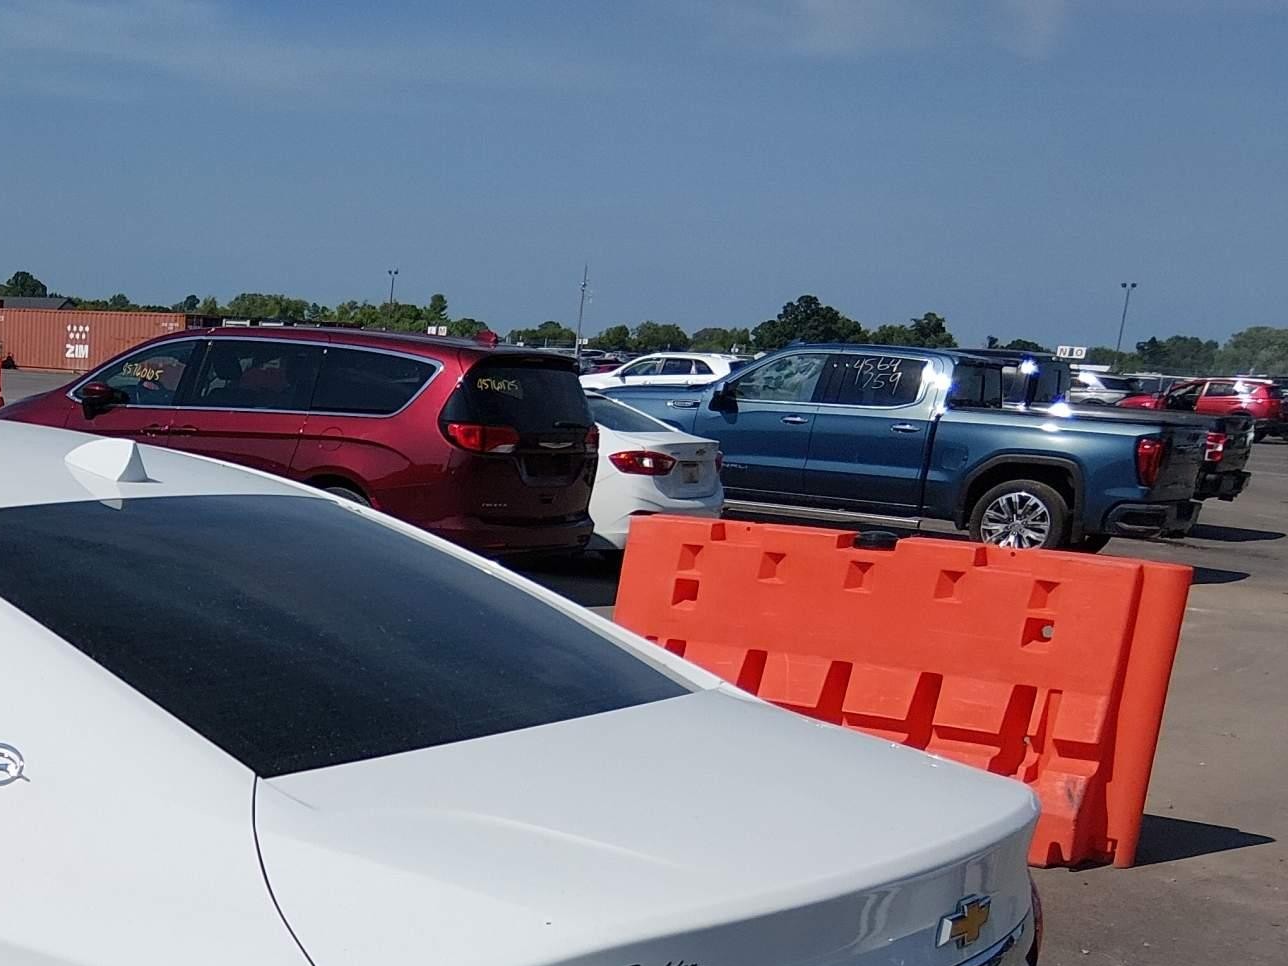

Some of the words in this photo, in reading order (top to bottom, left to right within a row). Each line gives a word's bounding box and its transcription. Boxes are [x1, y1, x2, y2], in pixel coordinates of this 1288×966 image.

[65, 343, 89, 359] ZIM
[853, 357, 902, 385] 4564
[862, 371, 902, 395] 759
